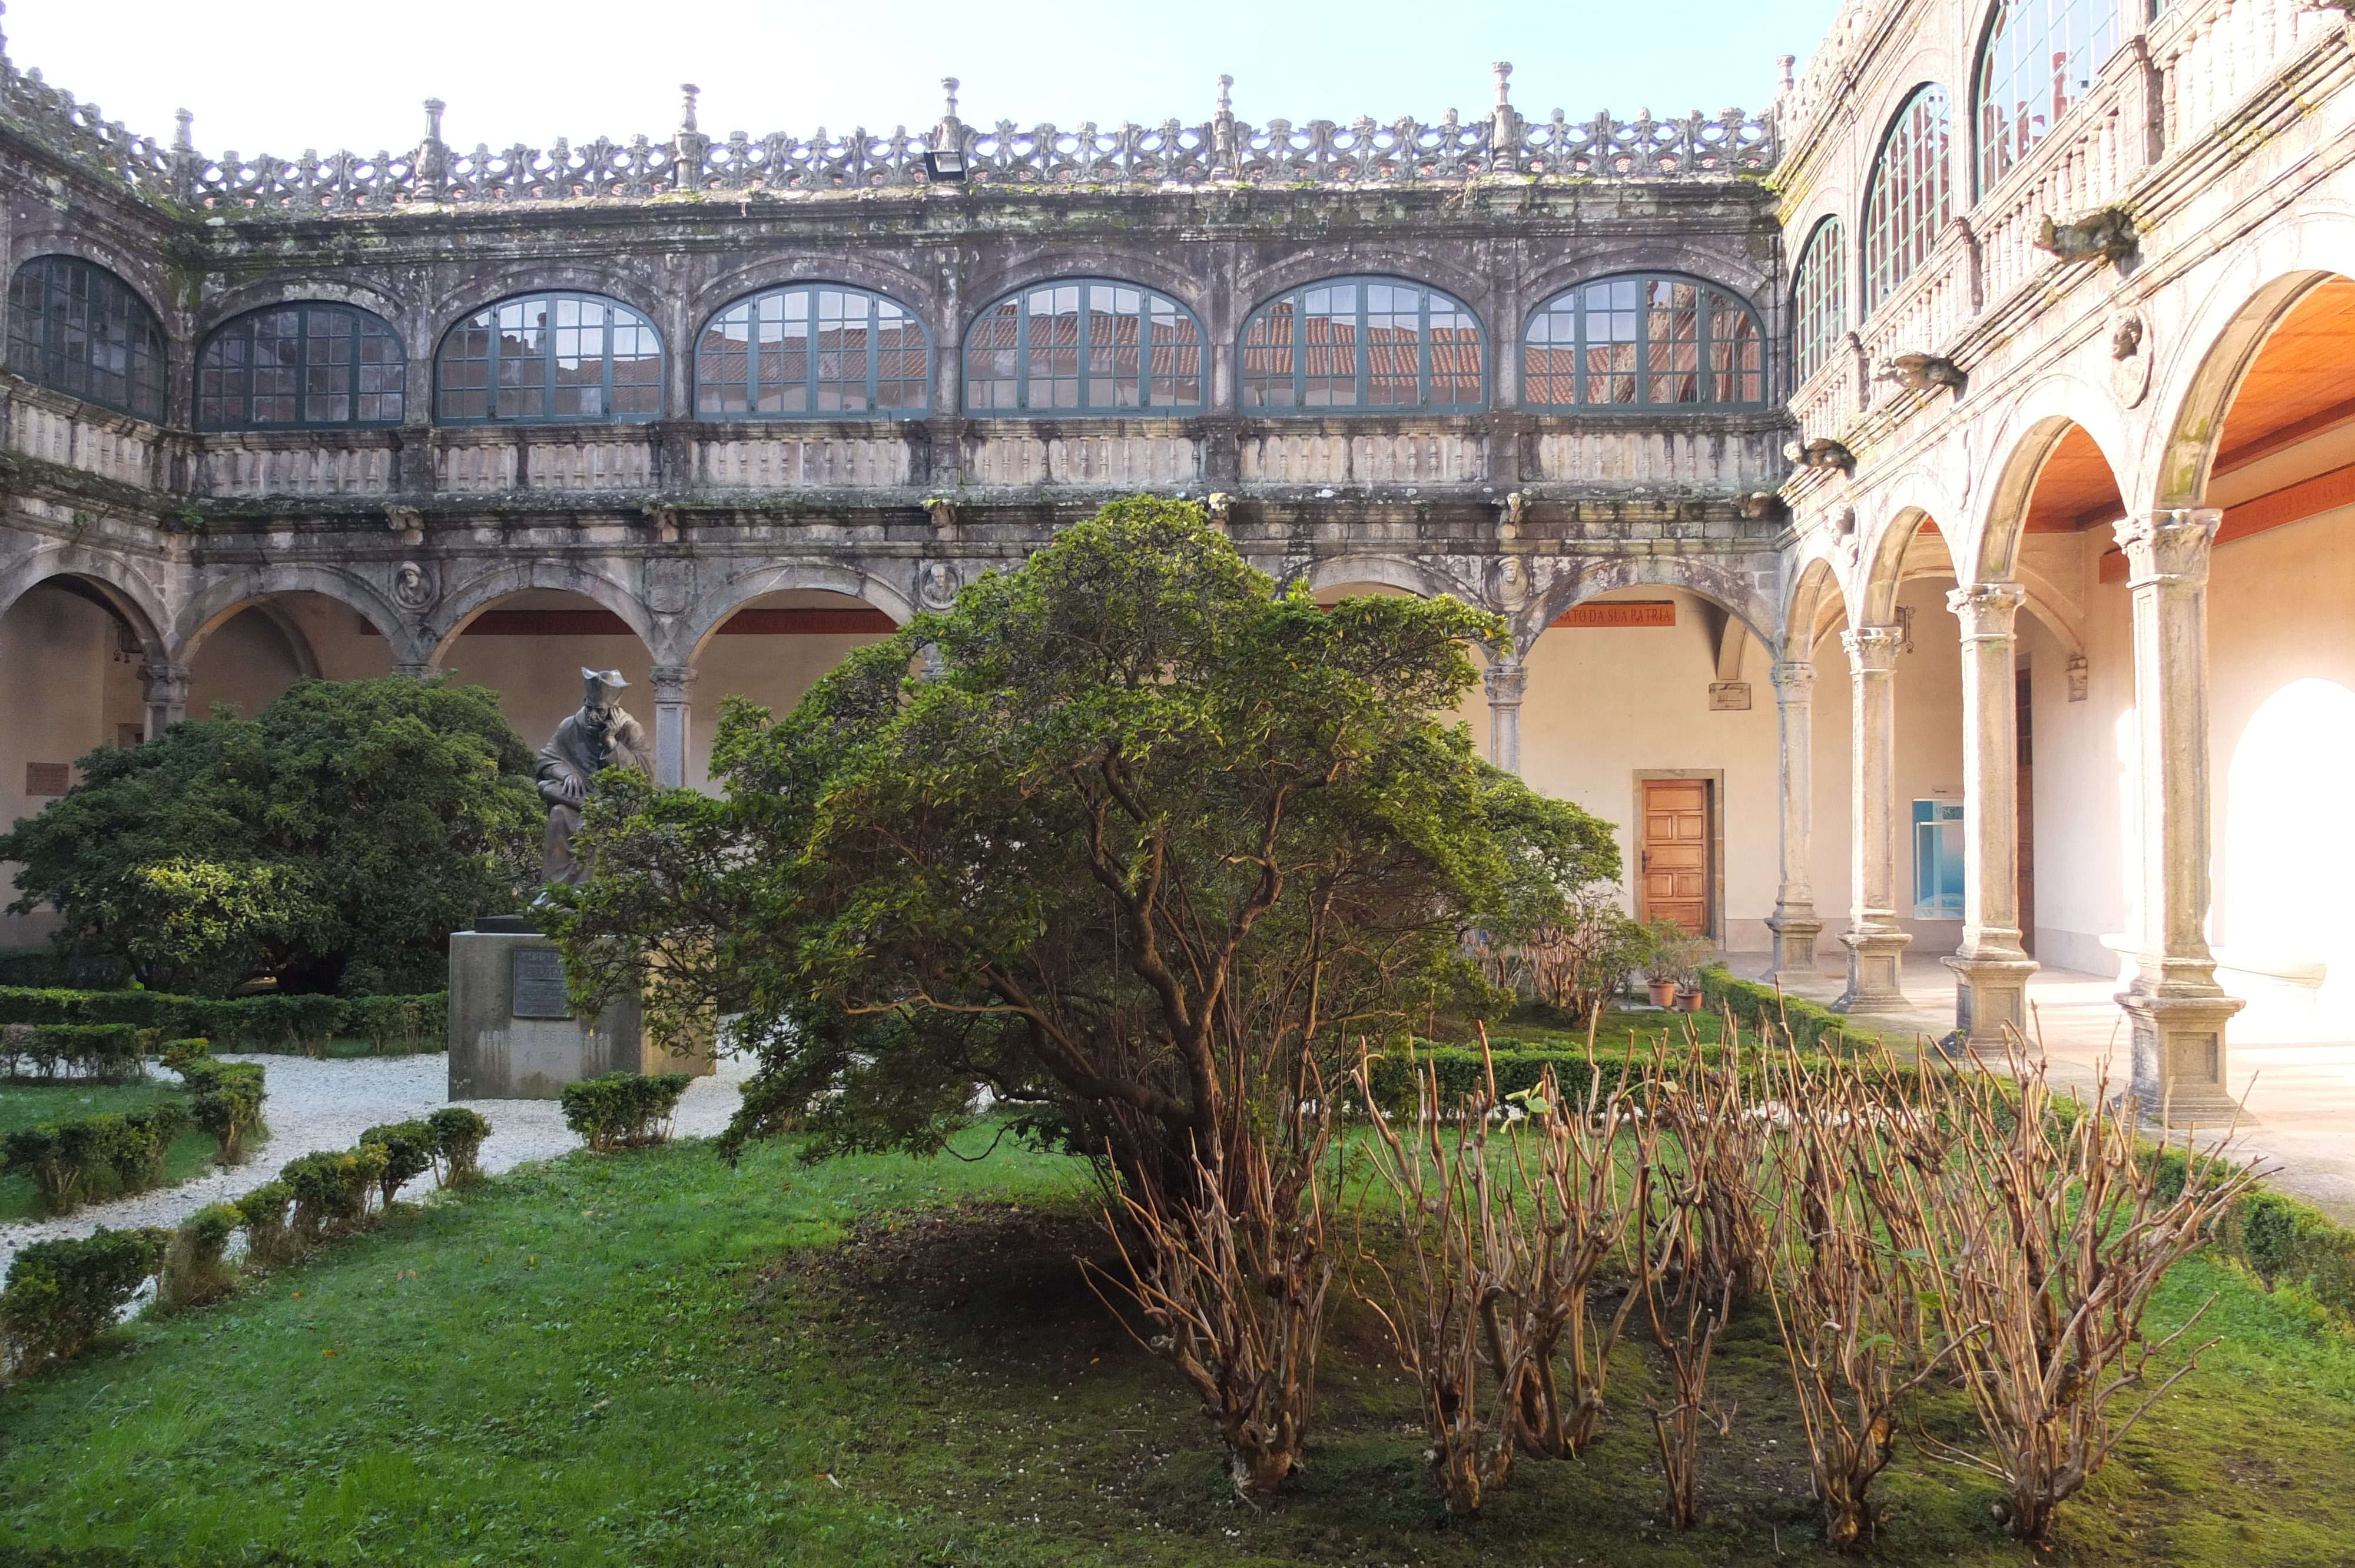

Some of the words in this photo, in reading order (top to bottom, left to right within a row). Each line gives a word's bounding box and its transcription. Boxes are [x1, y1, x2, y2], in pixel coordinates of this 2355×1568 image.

[1590, 609, 1604, 622] DA
[1630, 609, 1671, 622] PATRIA
[479, 1031, 522, 1042] ALONSO
[543, 1031, 557, 1042] DE
